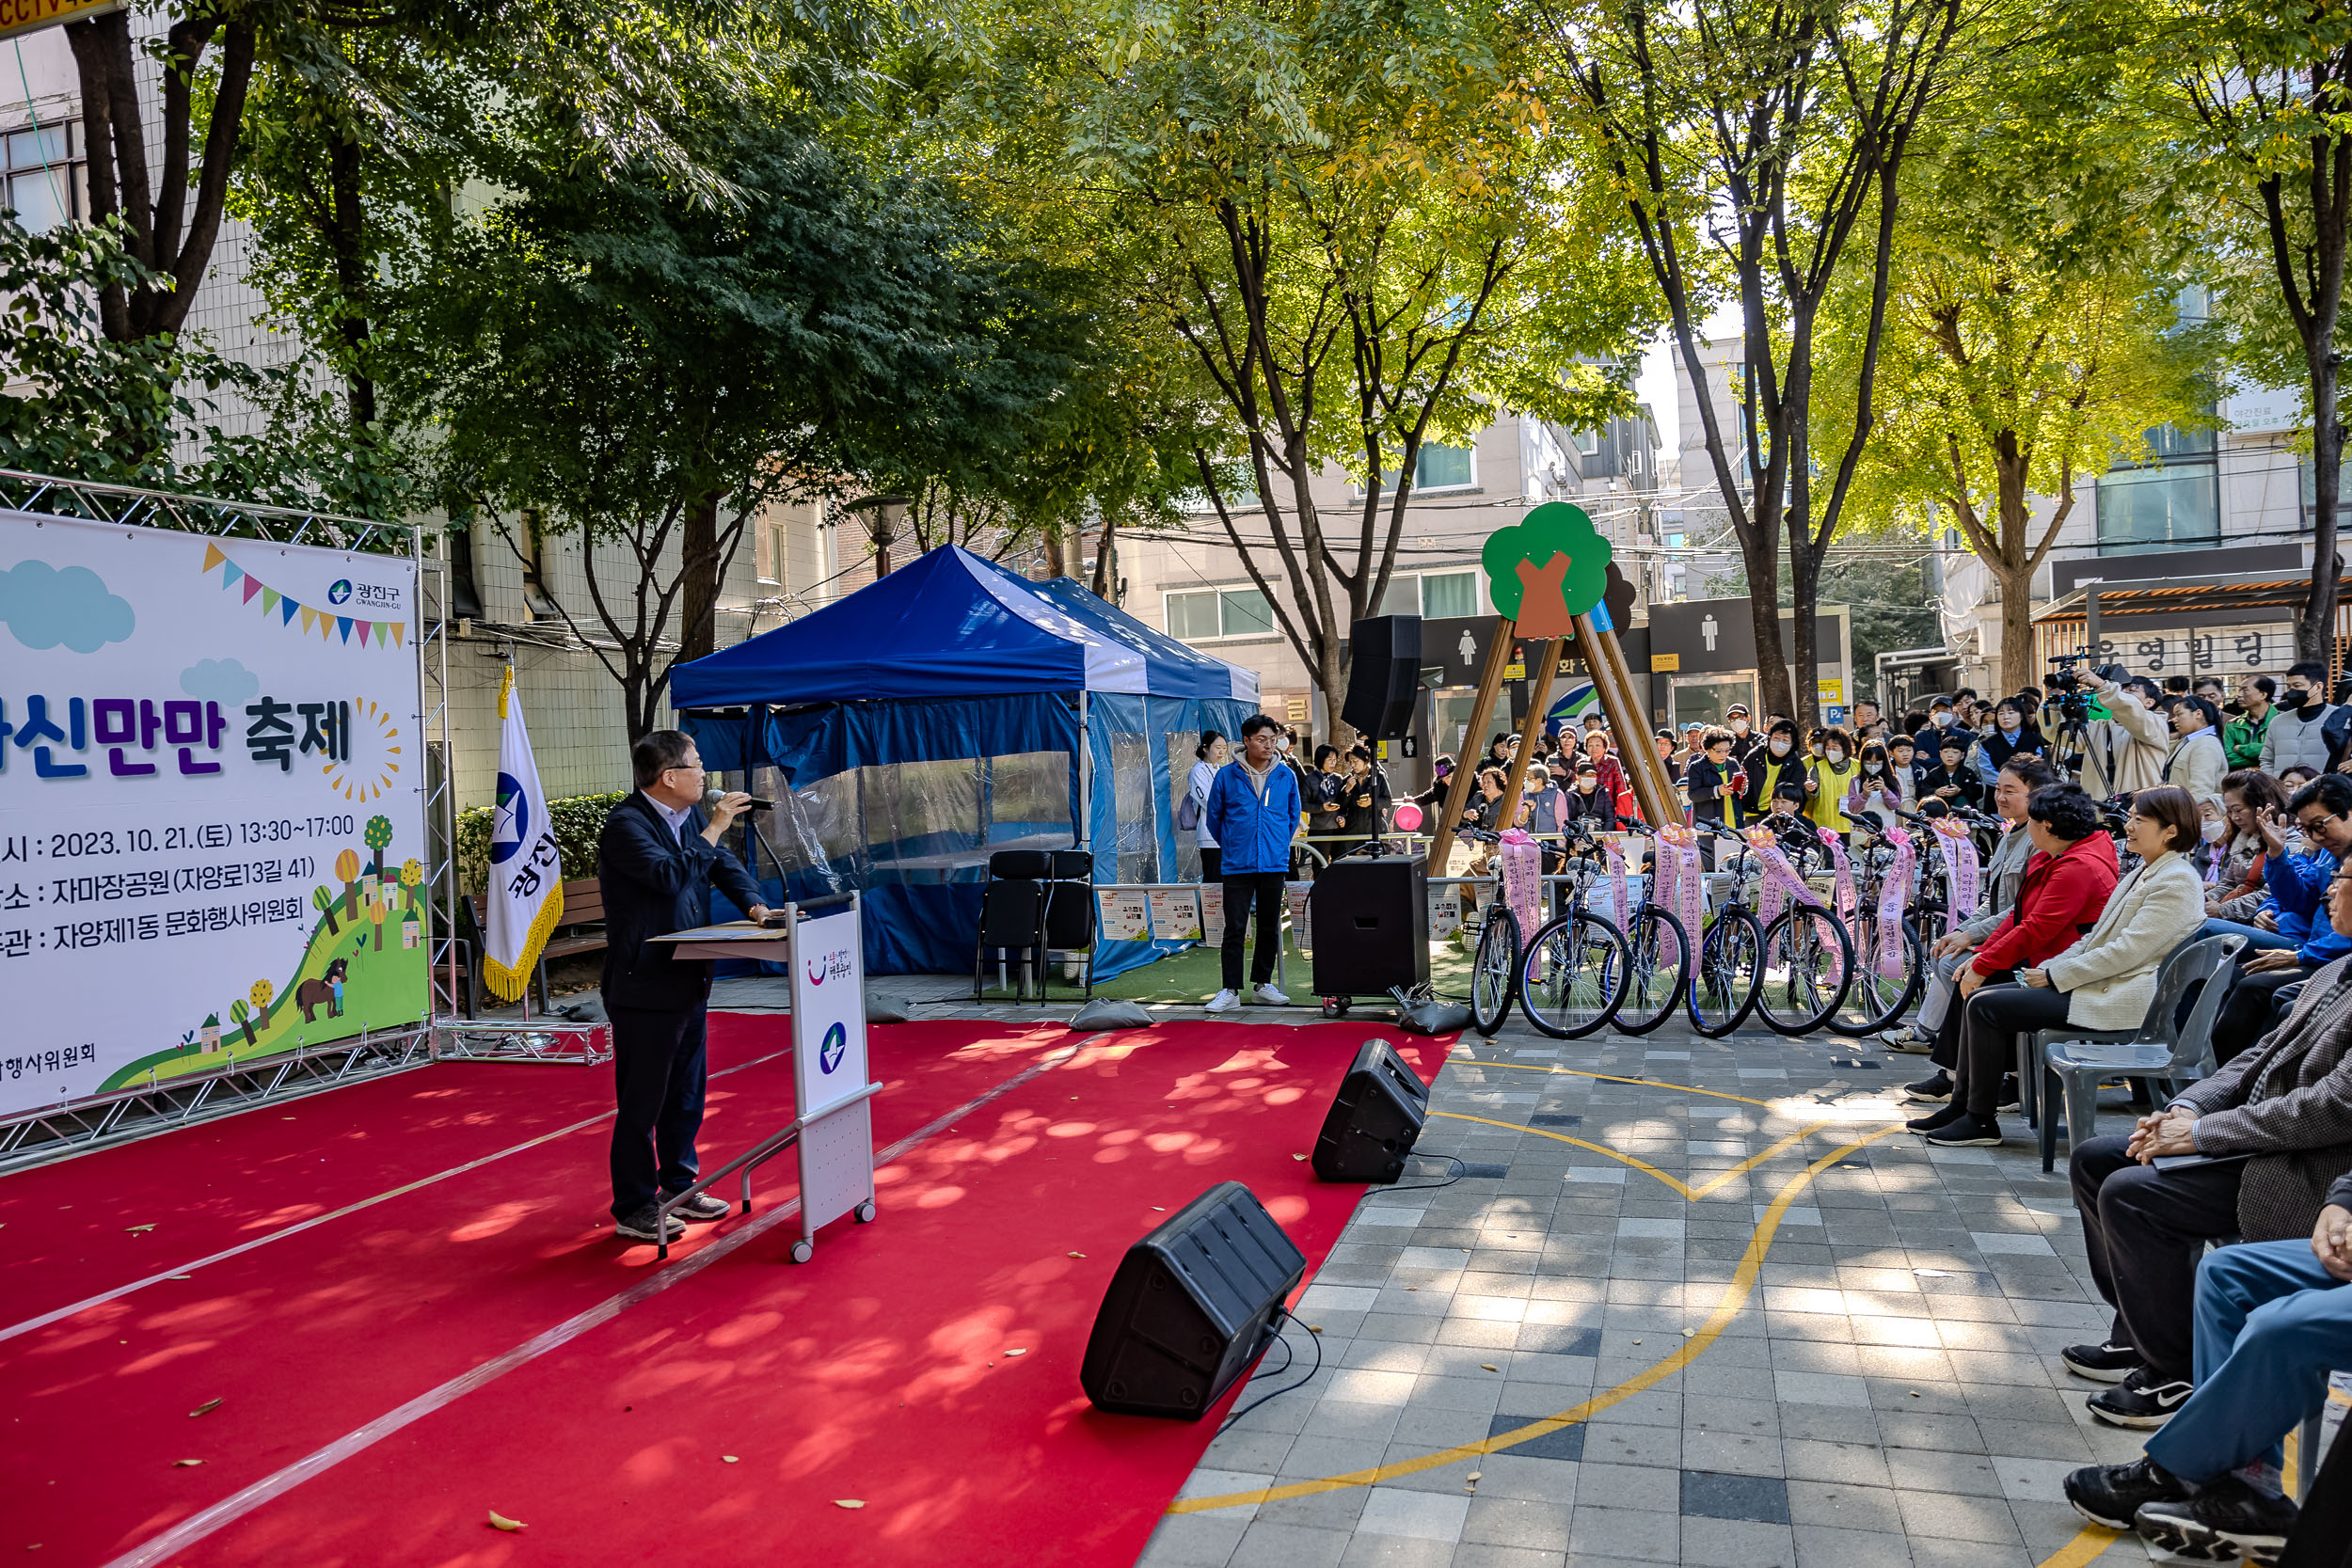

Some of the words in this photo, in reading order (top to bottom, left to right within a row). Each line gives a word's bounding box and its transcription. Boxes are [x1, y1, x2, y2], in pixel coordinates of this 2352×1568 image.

[2234, 406, 2272, 419] 야간진료
[356, 598, 402, 610] GWANGJIN-GU
[357, 583, 401, 602] 광진구
[0, 694, 227, 779] 신만만
[246, 695, 351, 772] 축제
[0, 833, 27, 863] 시
[51, 831, 121, 859] 2023.
[127, 829, 159, 852] 10.
[241, 815, 354, 844] 13:30~17:00
[508, 822, 558, 899] 광진
[0, 927, 33, 959] 관
[53, 913, 160, 951] 자양제1동
[166, 895, 304, 938] 문화행사위원회
[0, 1042, 95, 1082] 행사위원회
